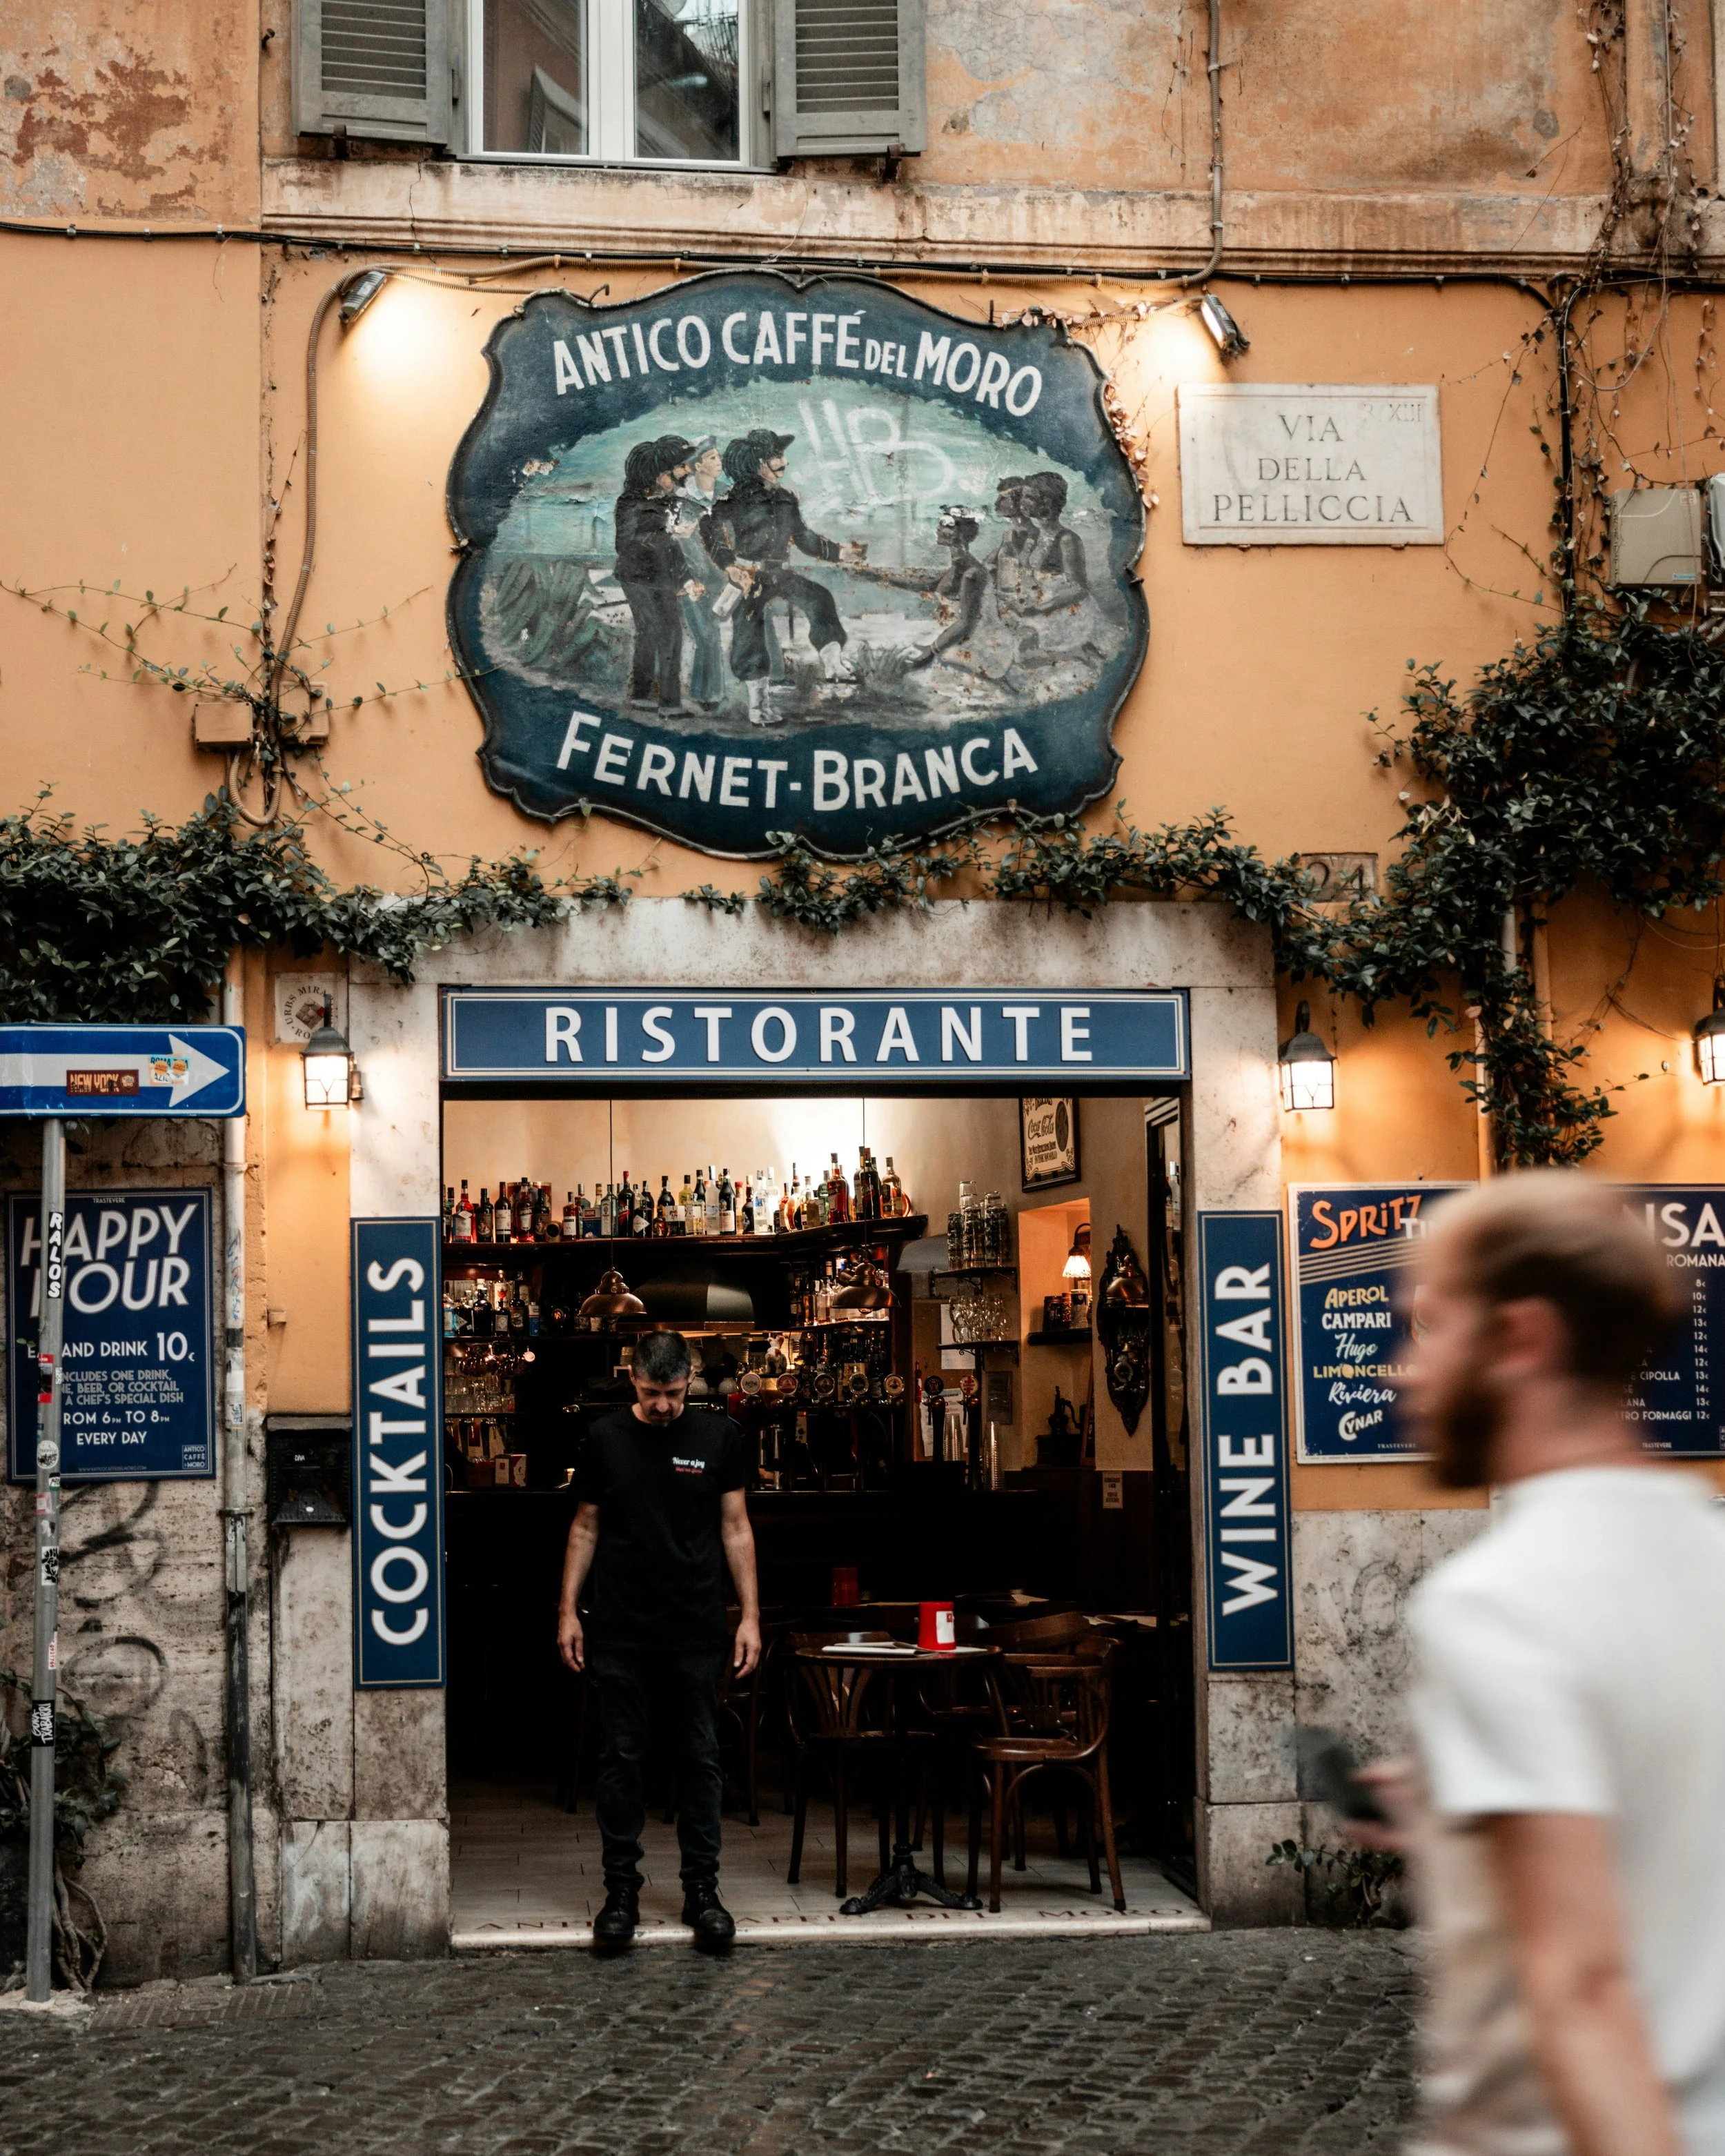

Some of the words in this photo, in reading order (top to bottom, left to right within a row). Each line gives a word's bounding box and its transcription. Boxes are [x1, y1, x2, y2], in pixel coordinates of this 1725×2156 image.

[553, 315, 712, 396] ANTICO
[722, 310, 866, 368] CAFFÉ
[864, 339, 908, 378] DEL
[914, 336, 1043, 417] MORO
[1279, 415, 1343, 442] VIA
[1258, 457, 1367, 481] DELLA
[1213, 495, 1414, 522] PELLICCIA
[284, 994, 297, 1025] URBS
[544, 1007, 1093, 1063] RISTORANTE
[48, 1212, 63, 1298] RALOS
[1666, 1254, 1725, 1267] ROMANA
[1324, 1285, 1389, 1309] APEROL
[1214, 1263, 1273, 1396] BAR
[1321, 1312, 1392, 1330] CAMPARI
[62, 1342, 94, 1357] AND
[101, 1341, 148, 1356] DRINK
[1334, 1333, 1378, 1364] Hugo
[61, 1371, 108, 1382] NCLUDES
[111, 1370, 134, 1381] ONE
[138, 1369, 172, 1382] DRINK,
[108, 1382, 124, 1393] OR
[128, 1381, 179, 1392] COCKTAIL
[1639, 1371, 1681, 1381] CIPOLLA
[65, 1396, 73, 1405] A
[77, 1394, 110, 1405] CHEF'S
[115, 1393, 156, 1404] SPECIAL
[160, 1392, 184, 1403] DISH
[1328, 1382, 1397, 1405] Riviera
[63, 1412, 96, 1425] ROM
[126, 1411, 146, 1423] TO
[1338, 1410, 1383, 1441] CYNAR
[1642, 1411, 1692, 1421] FORMAGGI
[77, 1432, 117, 1445] EVERY
[121, 1431, 148, 1444] DAY
[367, 1257, 428, 1645] COCKTAILS
[1219, 1434, 1278, 1615] WINE
[476, 1920, 666, 1930] ANTIO
